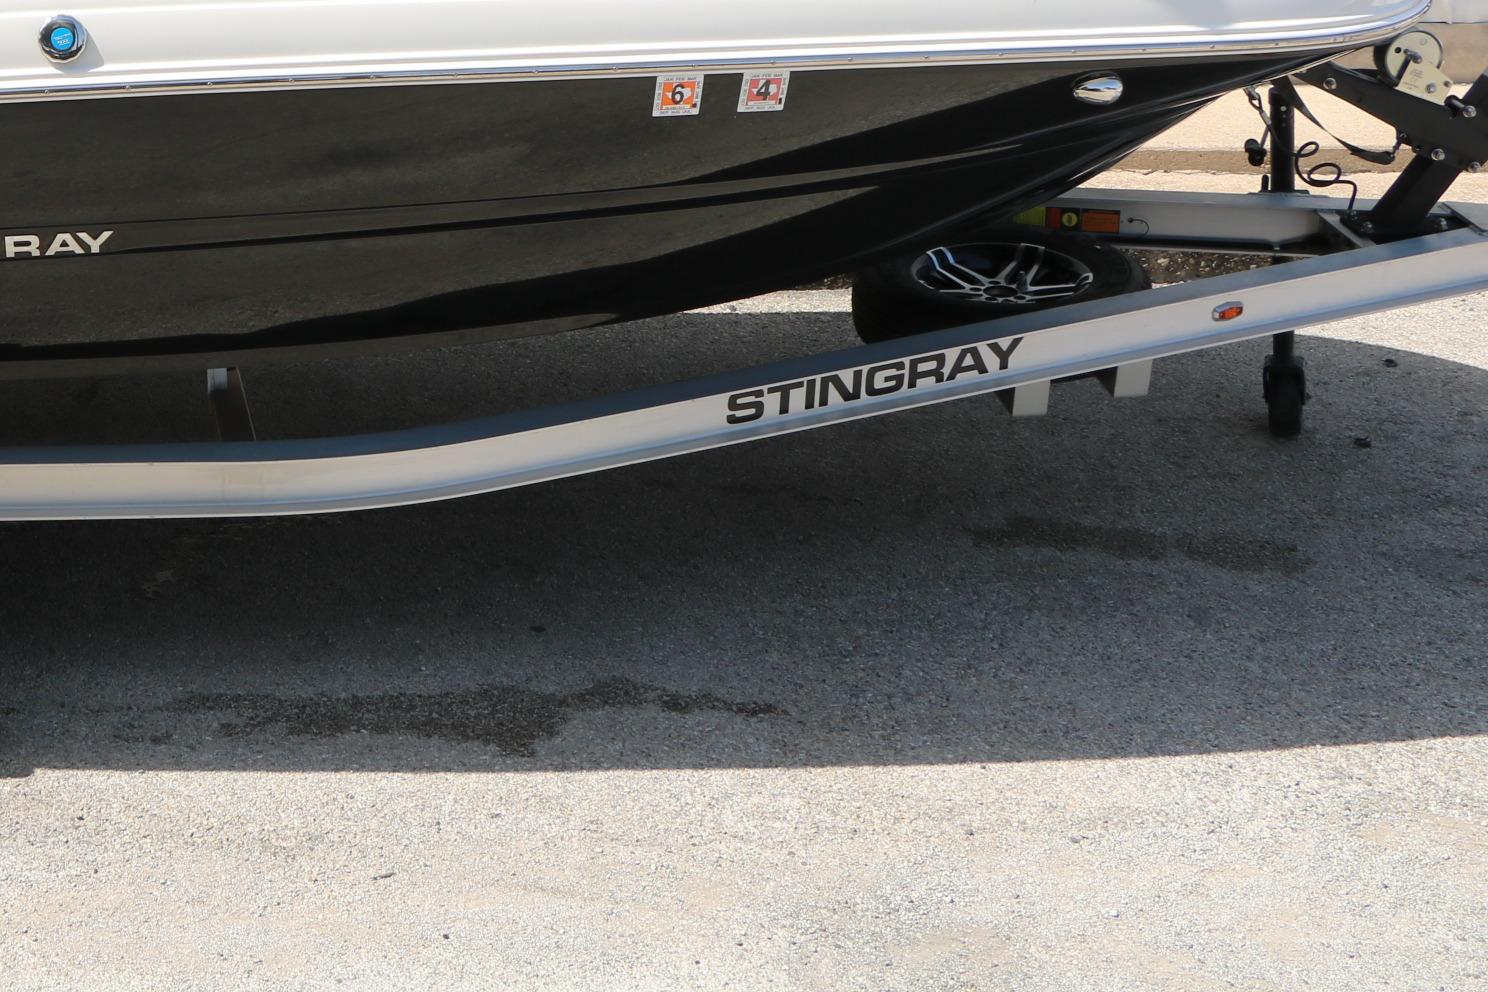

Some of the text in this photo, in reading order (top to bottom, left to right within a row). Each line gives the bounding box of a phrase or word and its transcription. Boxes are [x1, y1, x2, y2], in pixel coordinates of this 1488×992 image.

[670, 83, 685, 105] 6
[755, 78, 772, 102] 4
[726, 336, 1025, 425] STINGRAY
